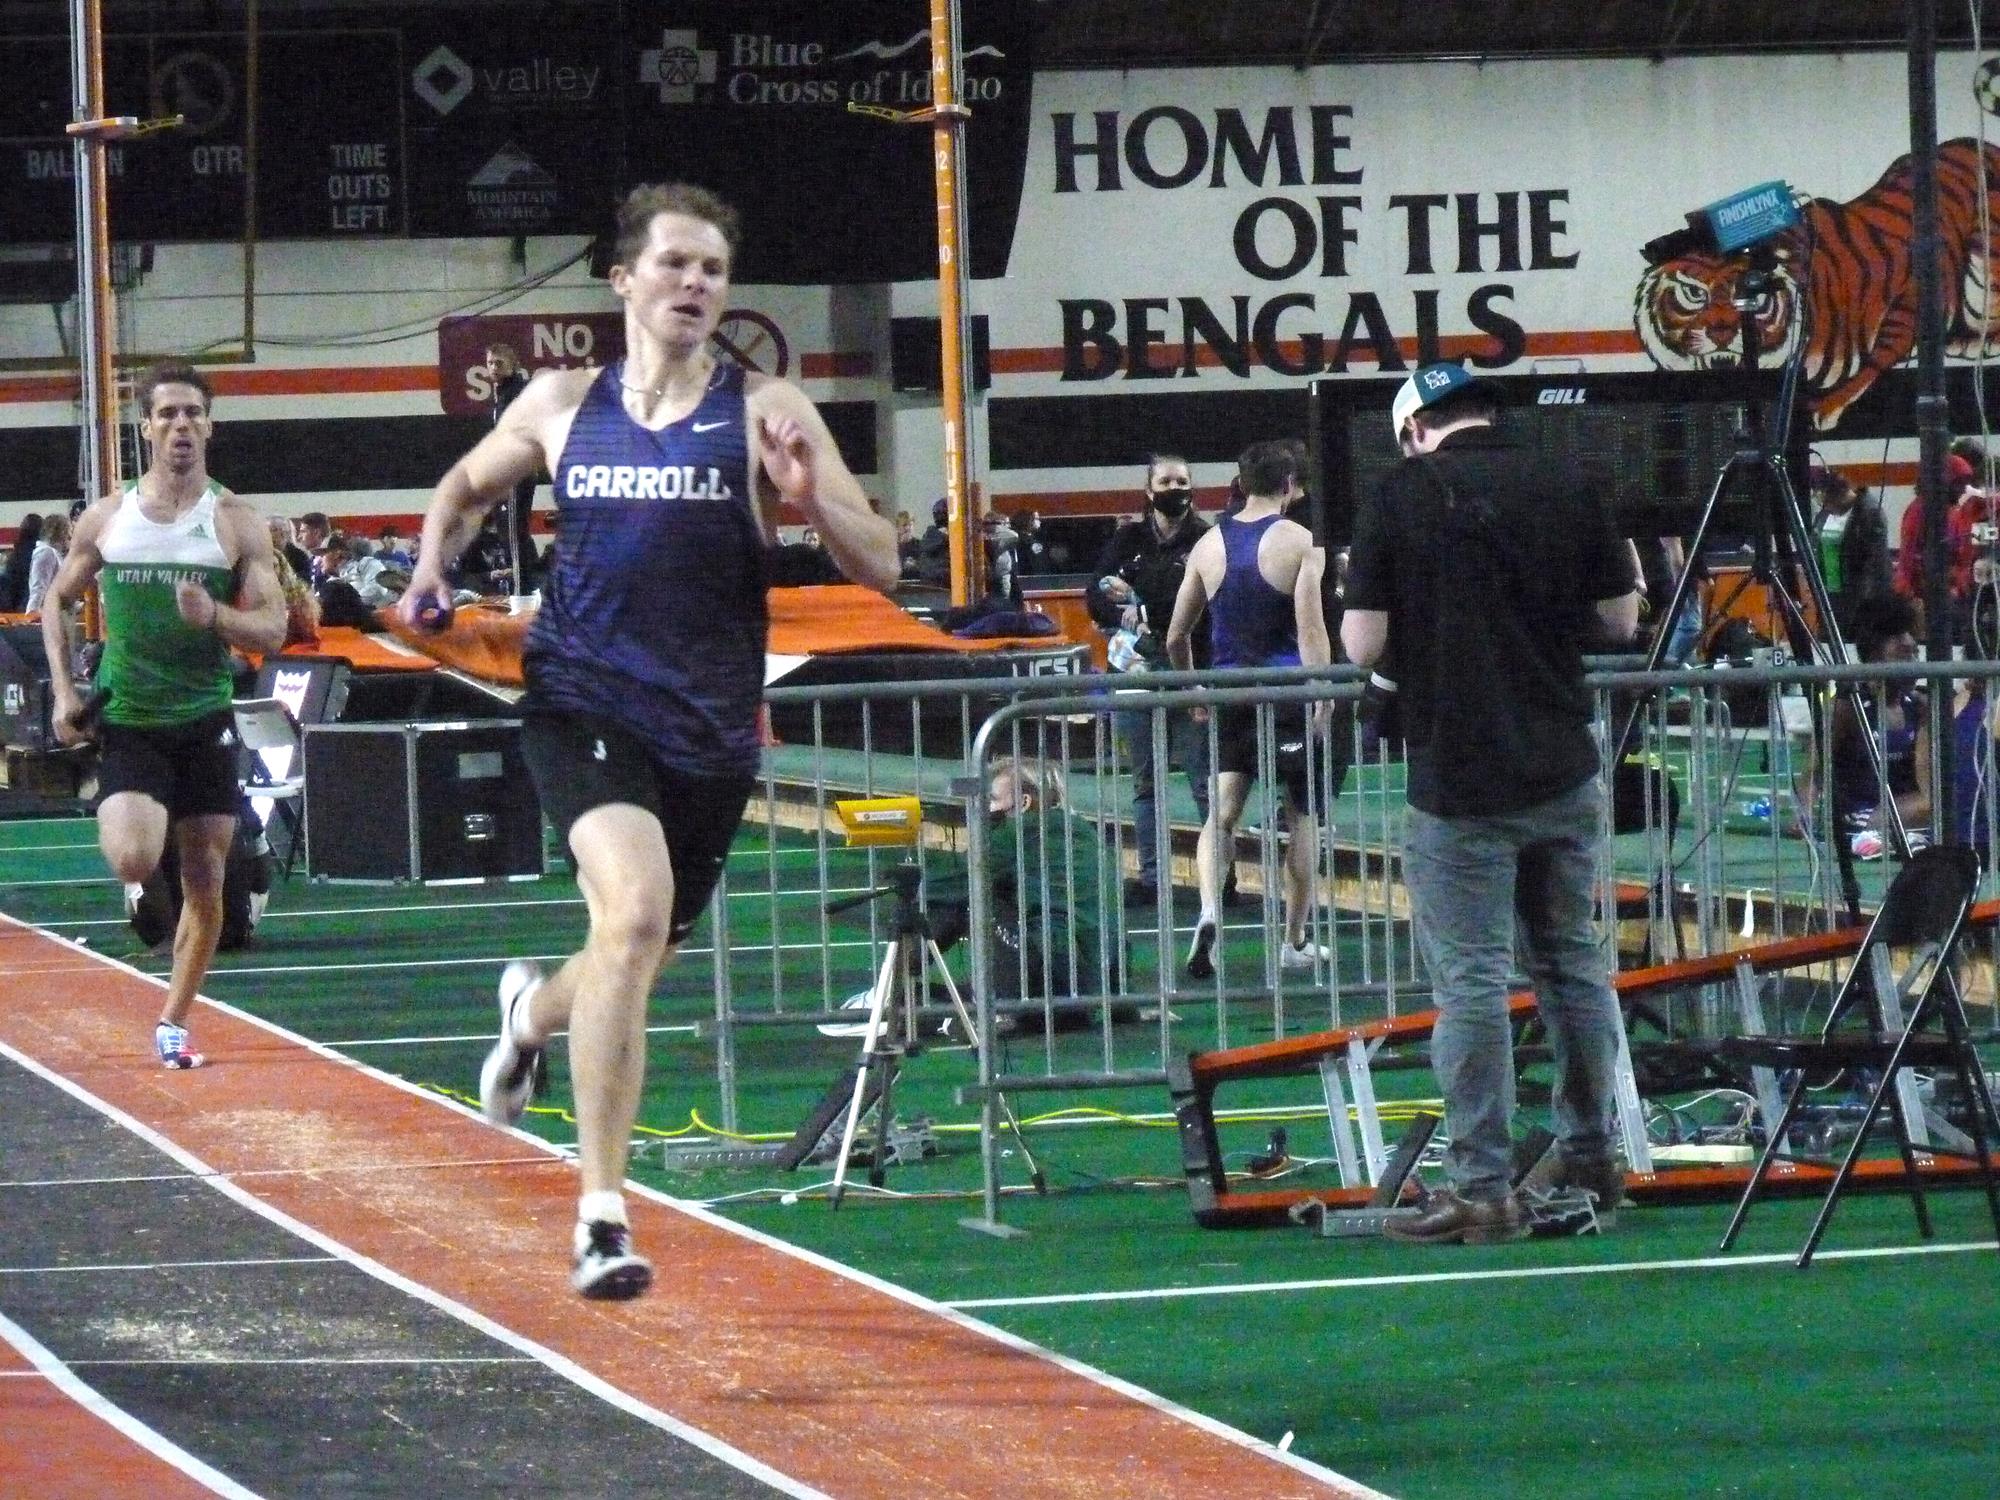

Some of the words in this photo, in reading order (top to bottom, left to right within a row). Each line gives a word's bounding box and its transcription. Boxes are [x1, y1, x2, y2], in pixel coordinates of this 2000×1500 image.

[729, 33, 824, 66] Blue
[482, 56, 601, 99] valley
[727, 72, 839, 103] Cross
[848, 70, 893, 102] of
[898, 69, 1002, 101] Idho
[27, 148, 74, 179] BAL
[192, 145, 247, 175] QTR
[329, 143, 388, 168] TIME
[1050, 104, 1365, 194] HOME
[327, 174, 392, 200] OUTS
[331, 204, 388, 230] LEFT
[1232, 196, 1362, 282] OF
[1388, 188, 1581, 275] THE
[533, 323, 594, 359] NO
[1057, 283, 1527, 383] BENGALS
[1537, 388, 1587, 404] GILL
[566, 464, 732, 501] CARROLL
[116, 569, 152, 584] UTAH
[157, 569, 208, 584] VALLEY
